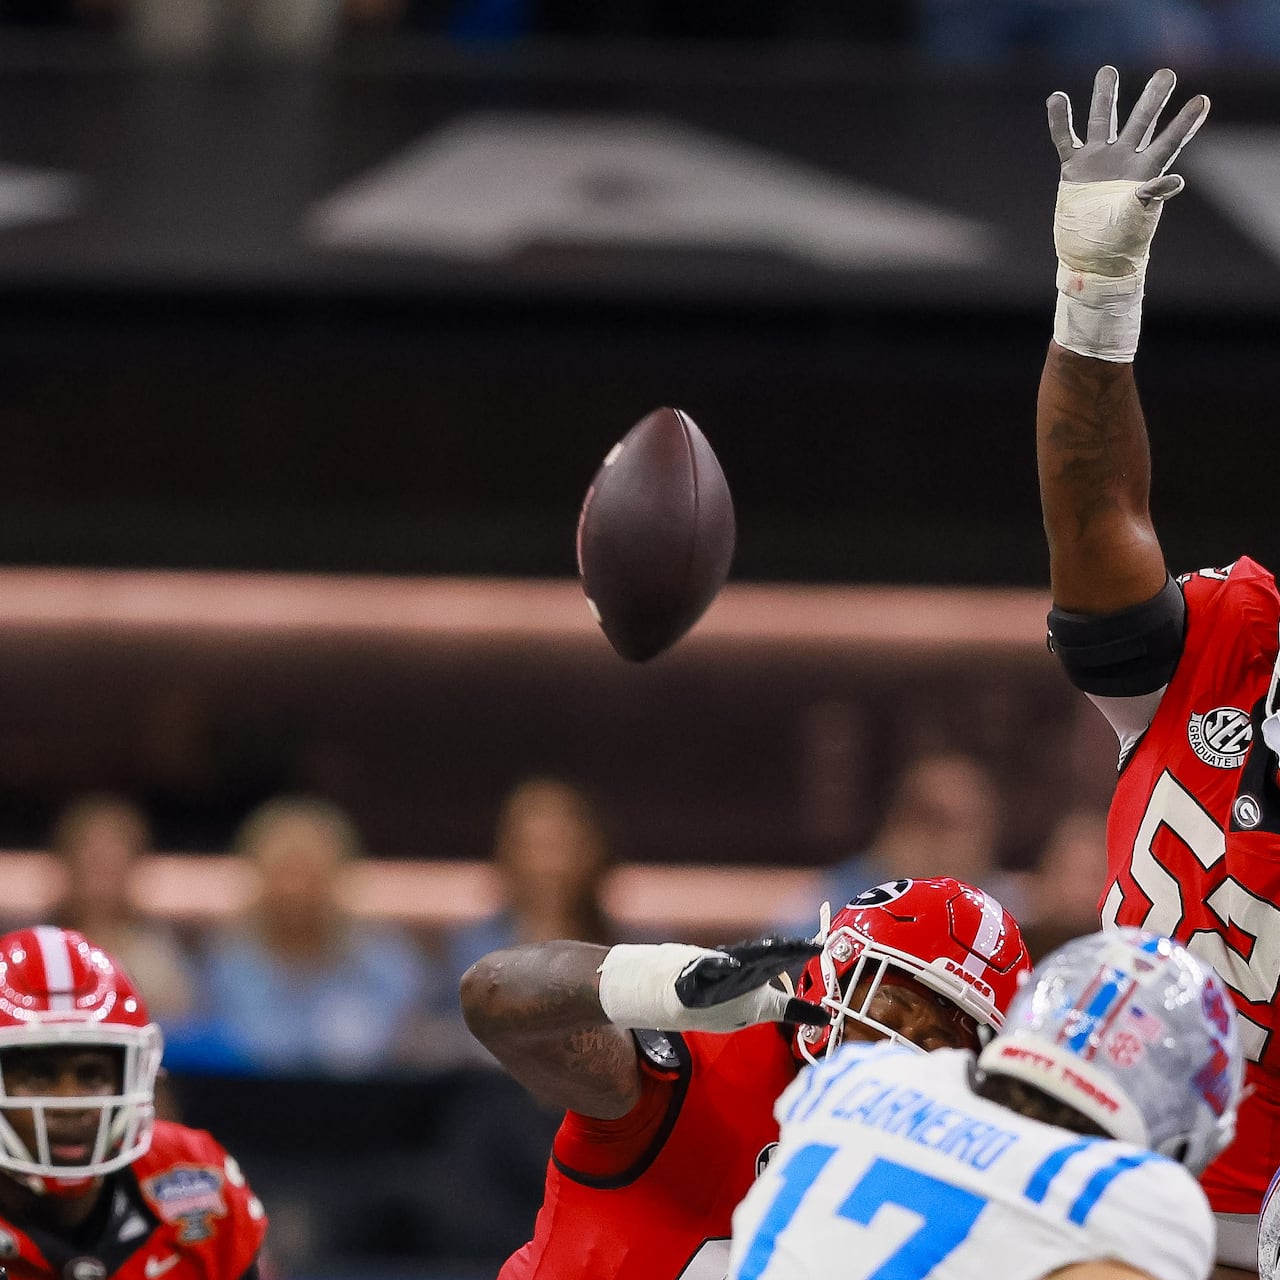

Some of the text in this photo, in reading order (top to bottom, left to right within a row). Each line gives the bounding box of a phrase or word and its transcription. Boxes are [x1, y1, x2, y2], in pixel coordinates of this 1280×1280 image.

[1189, 724, 1233, 767] GRADUATE
[1204, 710, 1253, 753] SEC
[944, 960, 993, 997] DAWGS
[830, 1077, 1019, 1173] CARNEIRO
